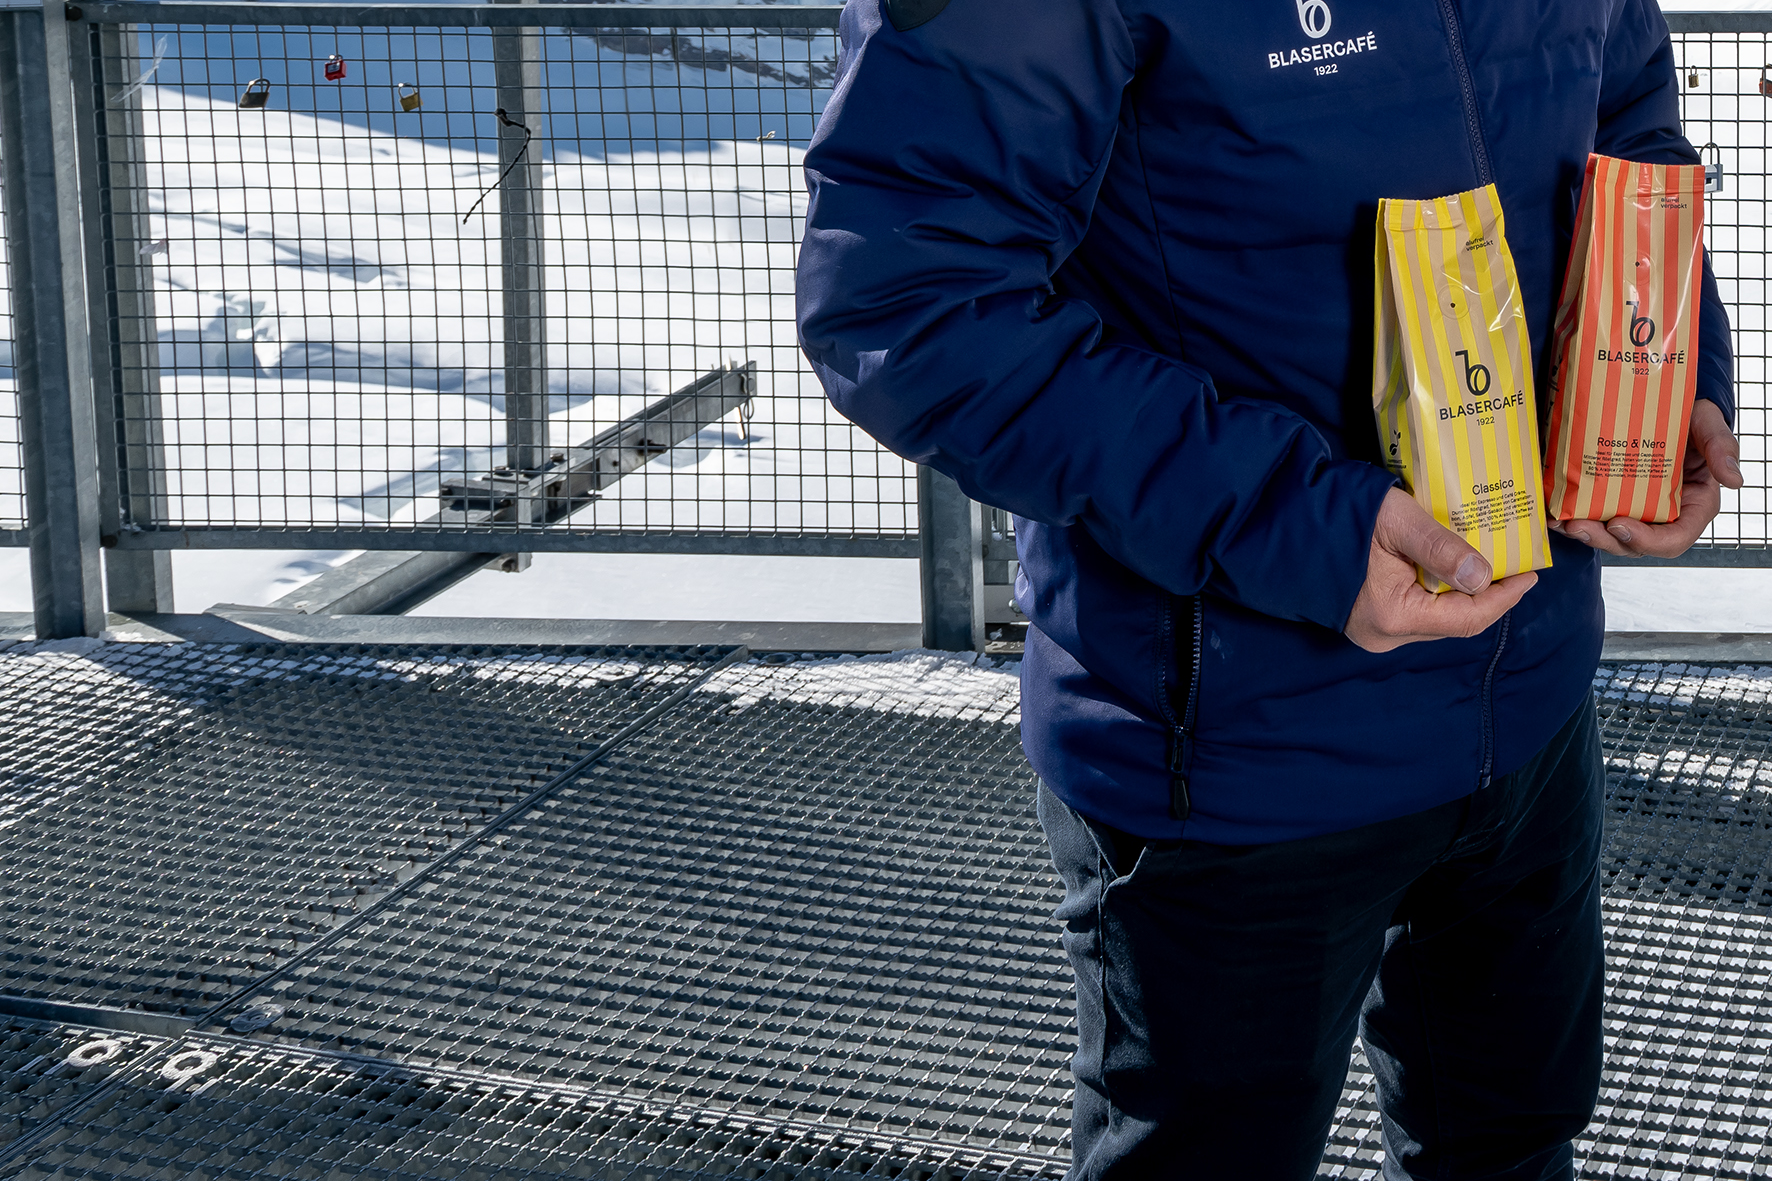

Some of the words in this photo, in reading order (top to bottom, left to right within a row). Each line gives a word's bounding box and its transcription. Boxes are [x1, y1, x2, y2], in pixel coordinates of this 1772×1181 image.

[1268, 31, 1377, 69] BLASERCAFÉ
[1313, 63, 1339, 77] 1922
[1466, 240, 1493, 251] verpackt
[1597, 350, 1685, 364] BLASERCAFÉ
[1631, 367, 1649, 375] 1922
[1439, 390, 1524, 420] BLASERCAFÉ
[1476, 416, 1495, 426] 1922
[1597, 436, 1628, 448] Rosso
[1631, 439, 1639, 448] &
[1641, 439, 1666, 449] Nero
[1472, 479, 1514, 496] Classico
